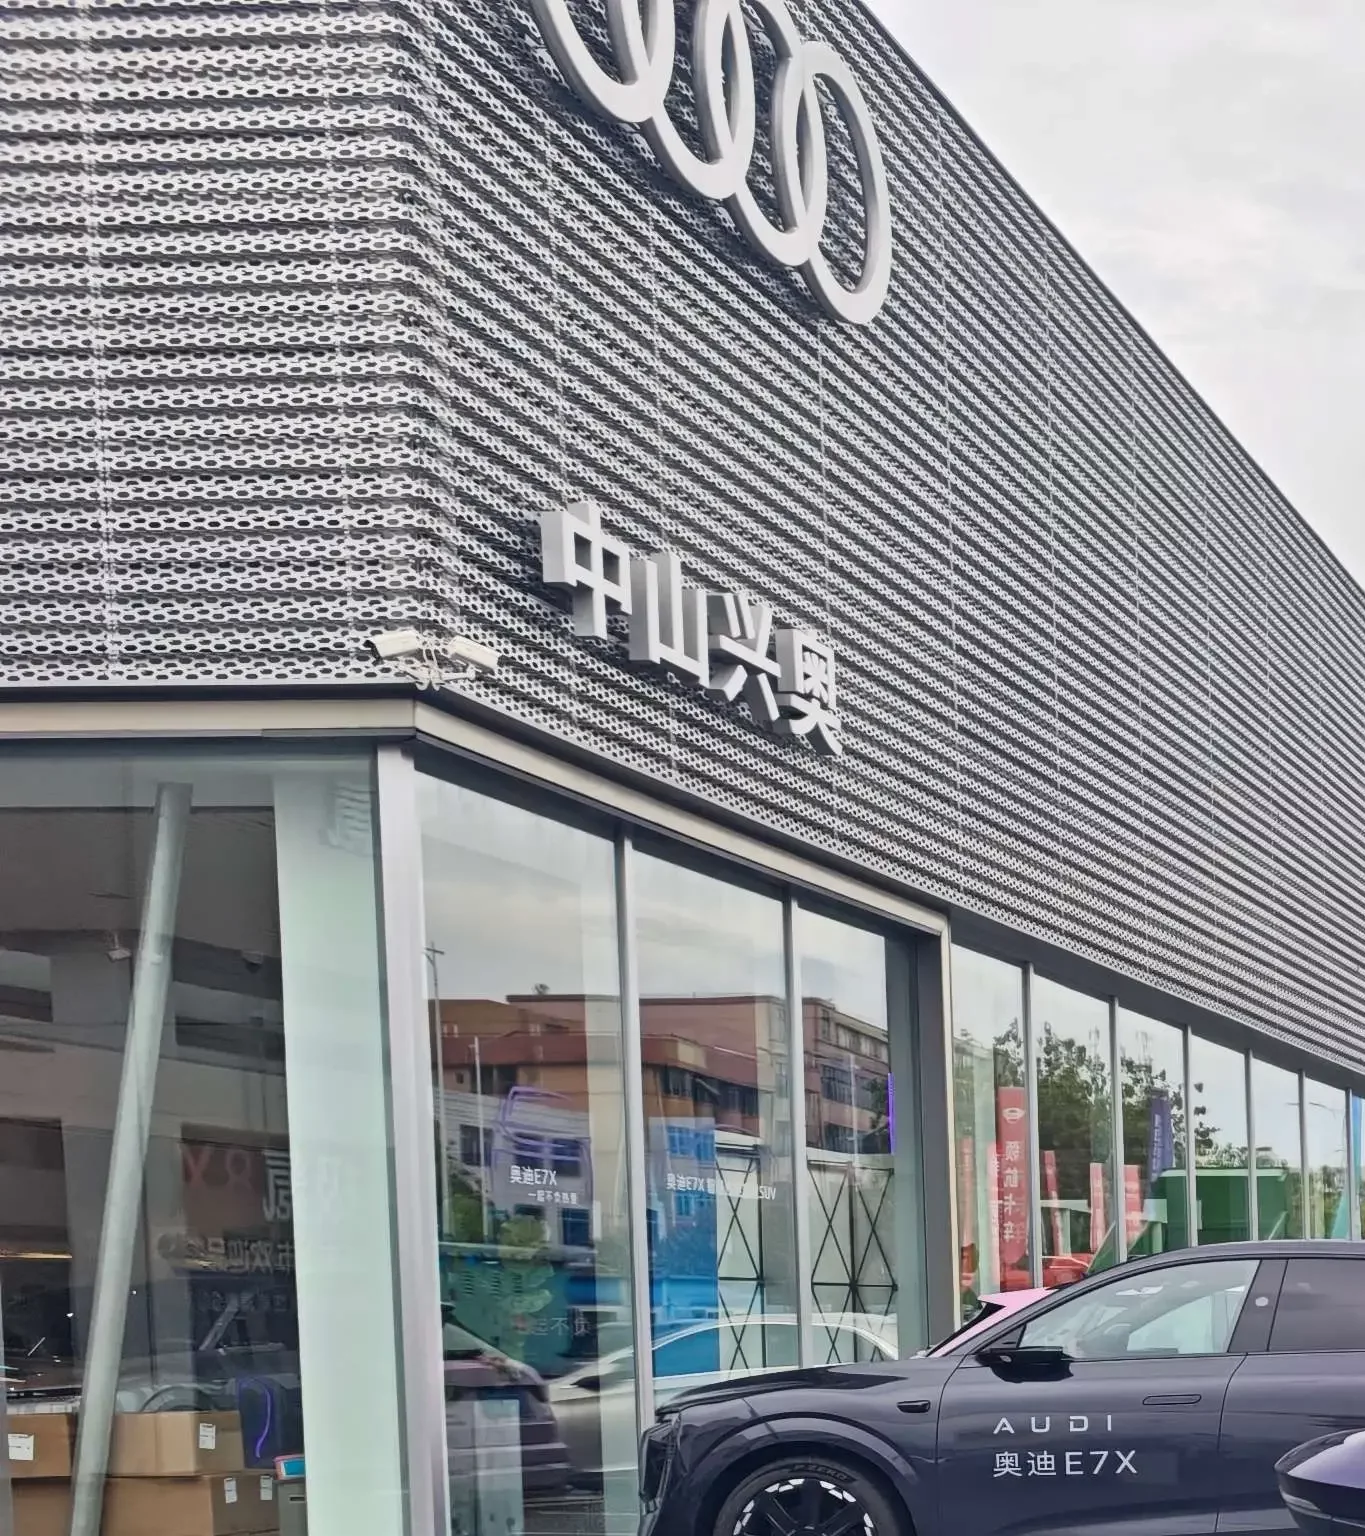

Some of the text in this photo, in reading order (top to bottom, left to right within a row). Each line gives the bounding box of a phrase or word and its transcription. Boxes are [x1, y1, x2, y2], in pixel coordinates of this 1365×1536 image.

[540, 502, 842, 755] 中山兴奥
[509, 1165, 557, 1186] 奥迪E7X
[993, 1415, 1113, 1434] AUDI
[992, 1449, 1138, 1478] 奥迪E7X
